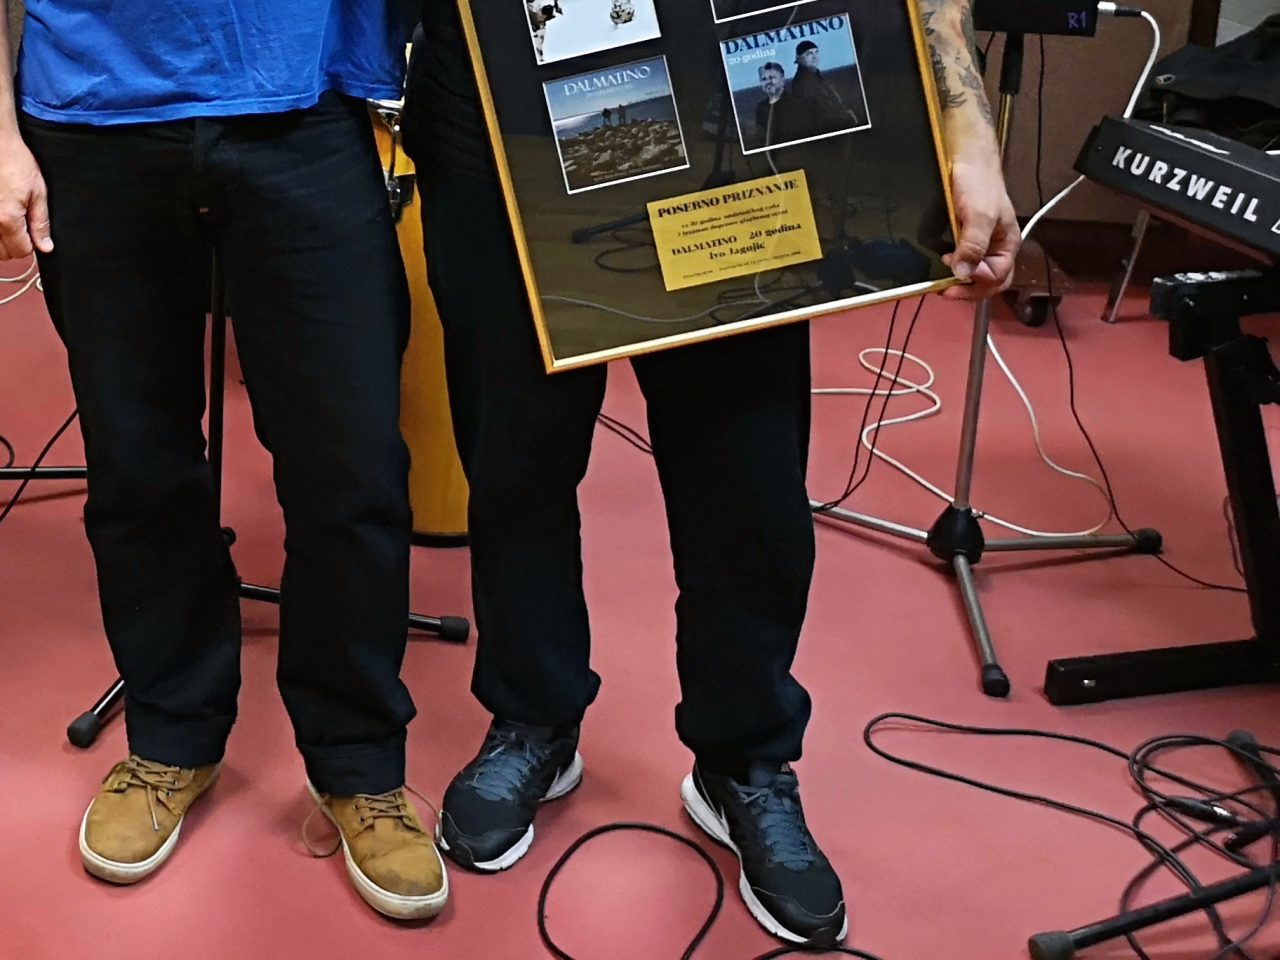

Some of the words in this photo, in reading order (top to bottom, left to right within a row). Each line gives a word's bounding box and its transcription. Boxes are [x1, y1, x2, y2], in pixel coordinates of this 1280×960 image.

[724, 15, 844, 55] DALMATINO
[1067, 10, 1089, 29] R1
[563, 66, 651, 96] DALMATINO
[1112, 145, 1260, 223] KURZWEIL
[671, 235, 737, 256] DALMATINO
[749, 230, 763, 240] 20
[764, 223, 802, 237] godina
